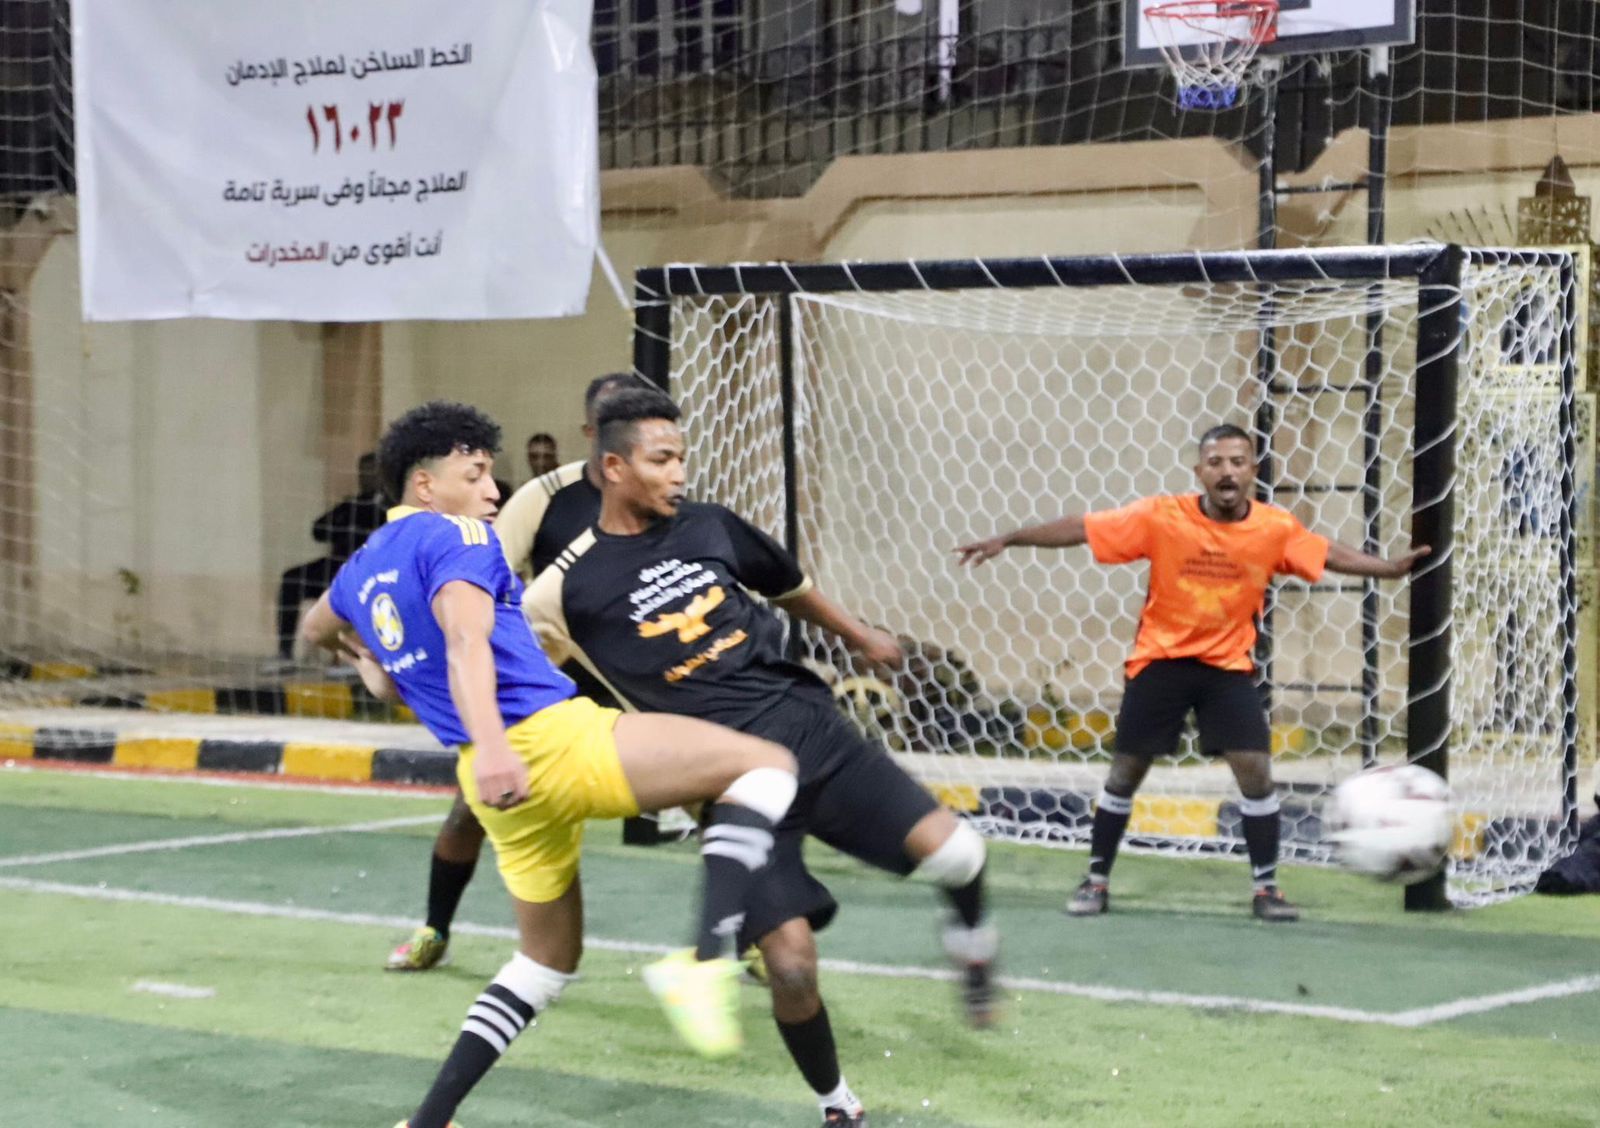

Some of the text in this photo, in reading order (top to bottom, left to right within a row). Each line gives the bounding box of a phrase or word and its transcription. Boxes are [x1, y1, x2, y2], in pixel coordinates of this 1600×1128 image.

[226, 43, 472, 86] الخط الساخن لعلاج الإدمان
[306, 99, 404, 154] ١٦٠٢٣
[222, 180, 267, 202] تامة
[270, 179, 319, 207] سرية
[416, 170, 467, 203] العلاج
[246, 231, 442, 267] أنت أقوى من المخدرات
